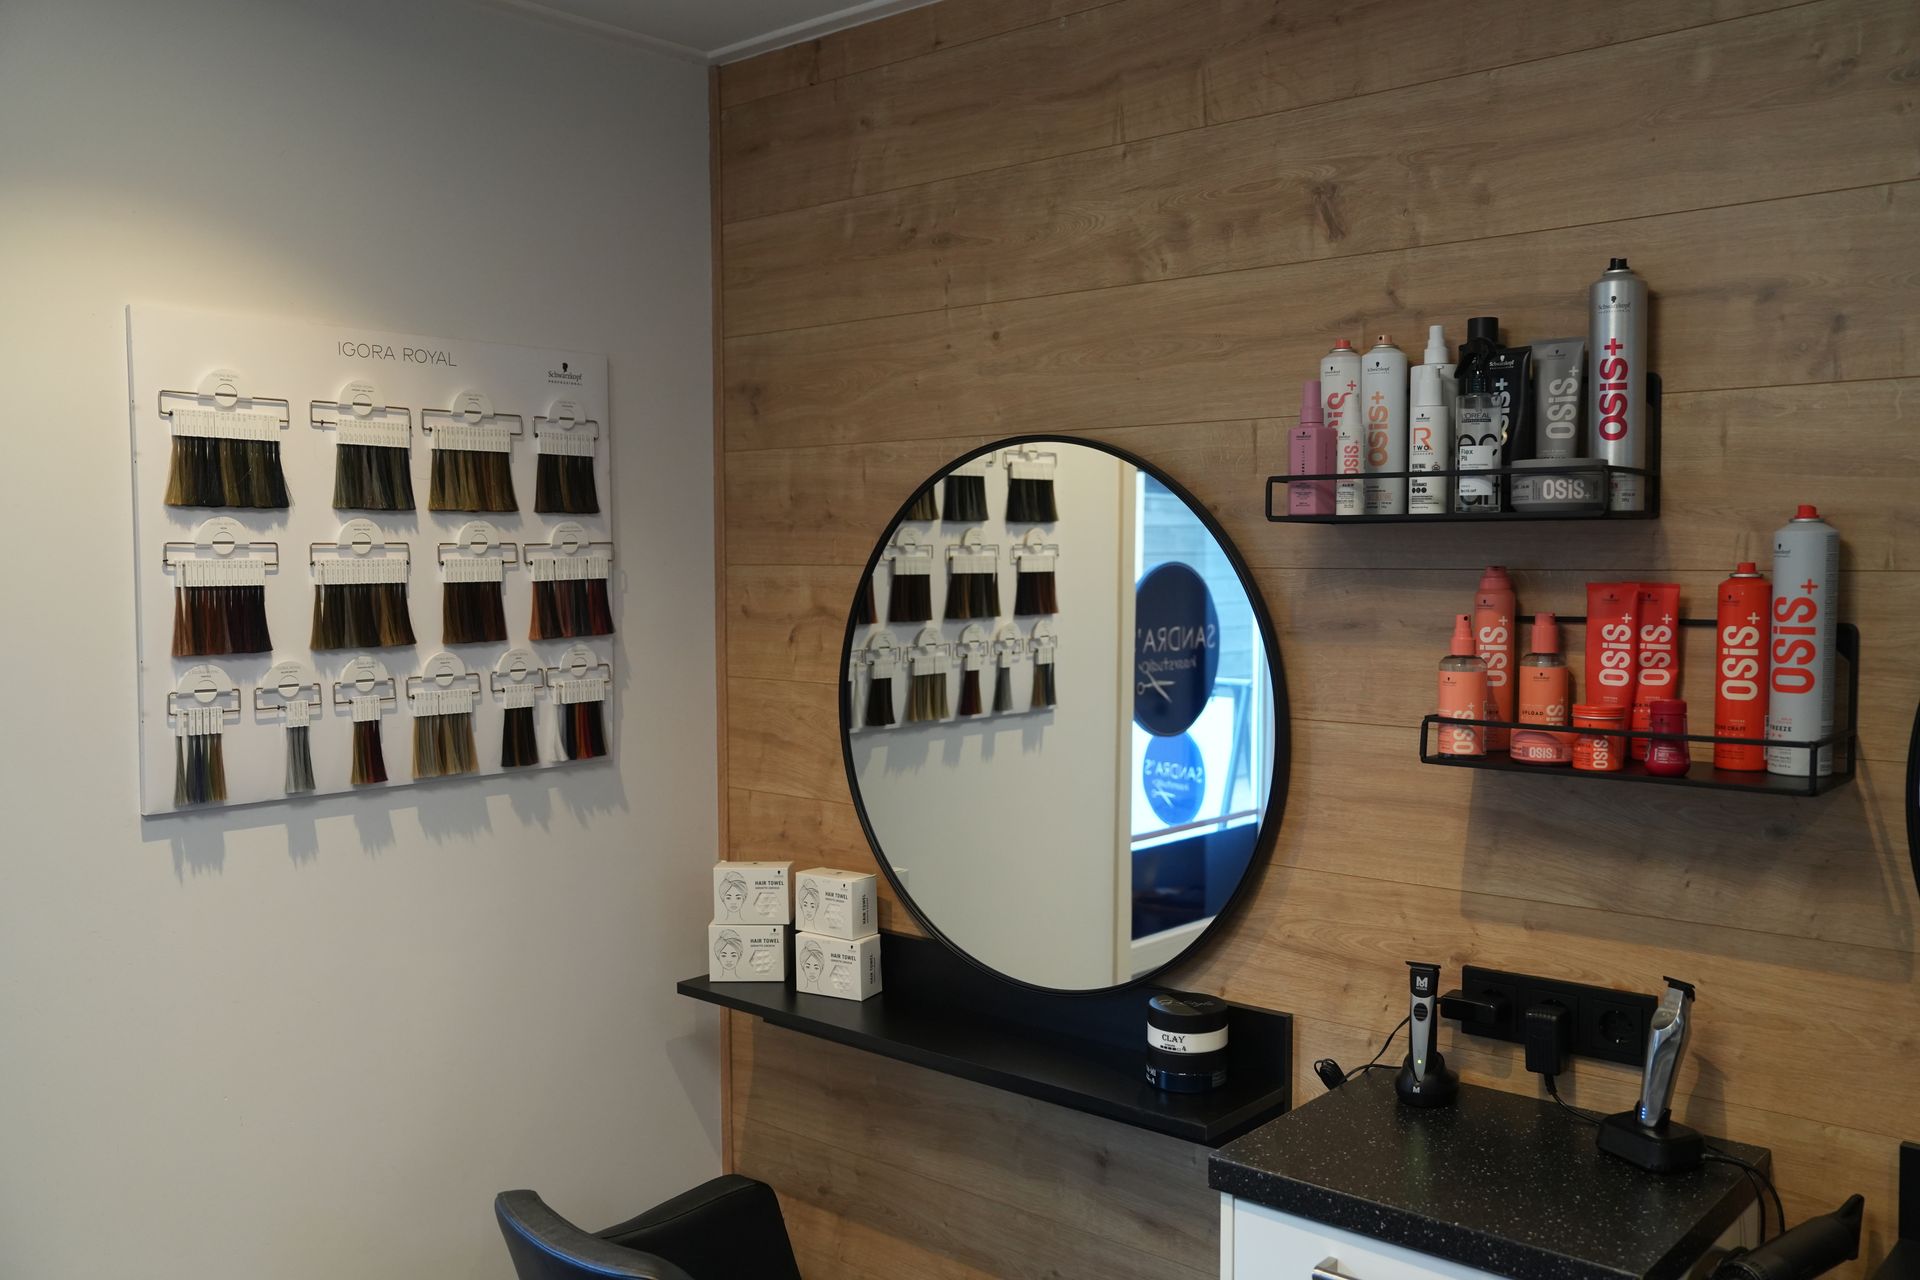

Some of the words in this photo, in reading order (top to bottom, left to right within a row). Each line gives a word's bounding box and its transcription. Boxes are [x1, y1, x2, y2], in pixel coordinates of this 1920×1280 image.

[338, 341, 396, 361] IGORA
[402, 347, 458, 367] ROYAL
[837, 893, 849, 901] TOWEL
[842, 954, 857, 962] TOWEL
[1161, 1034, 1186, 1044] CLAY
